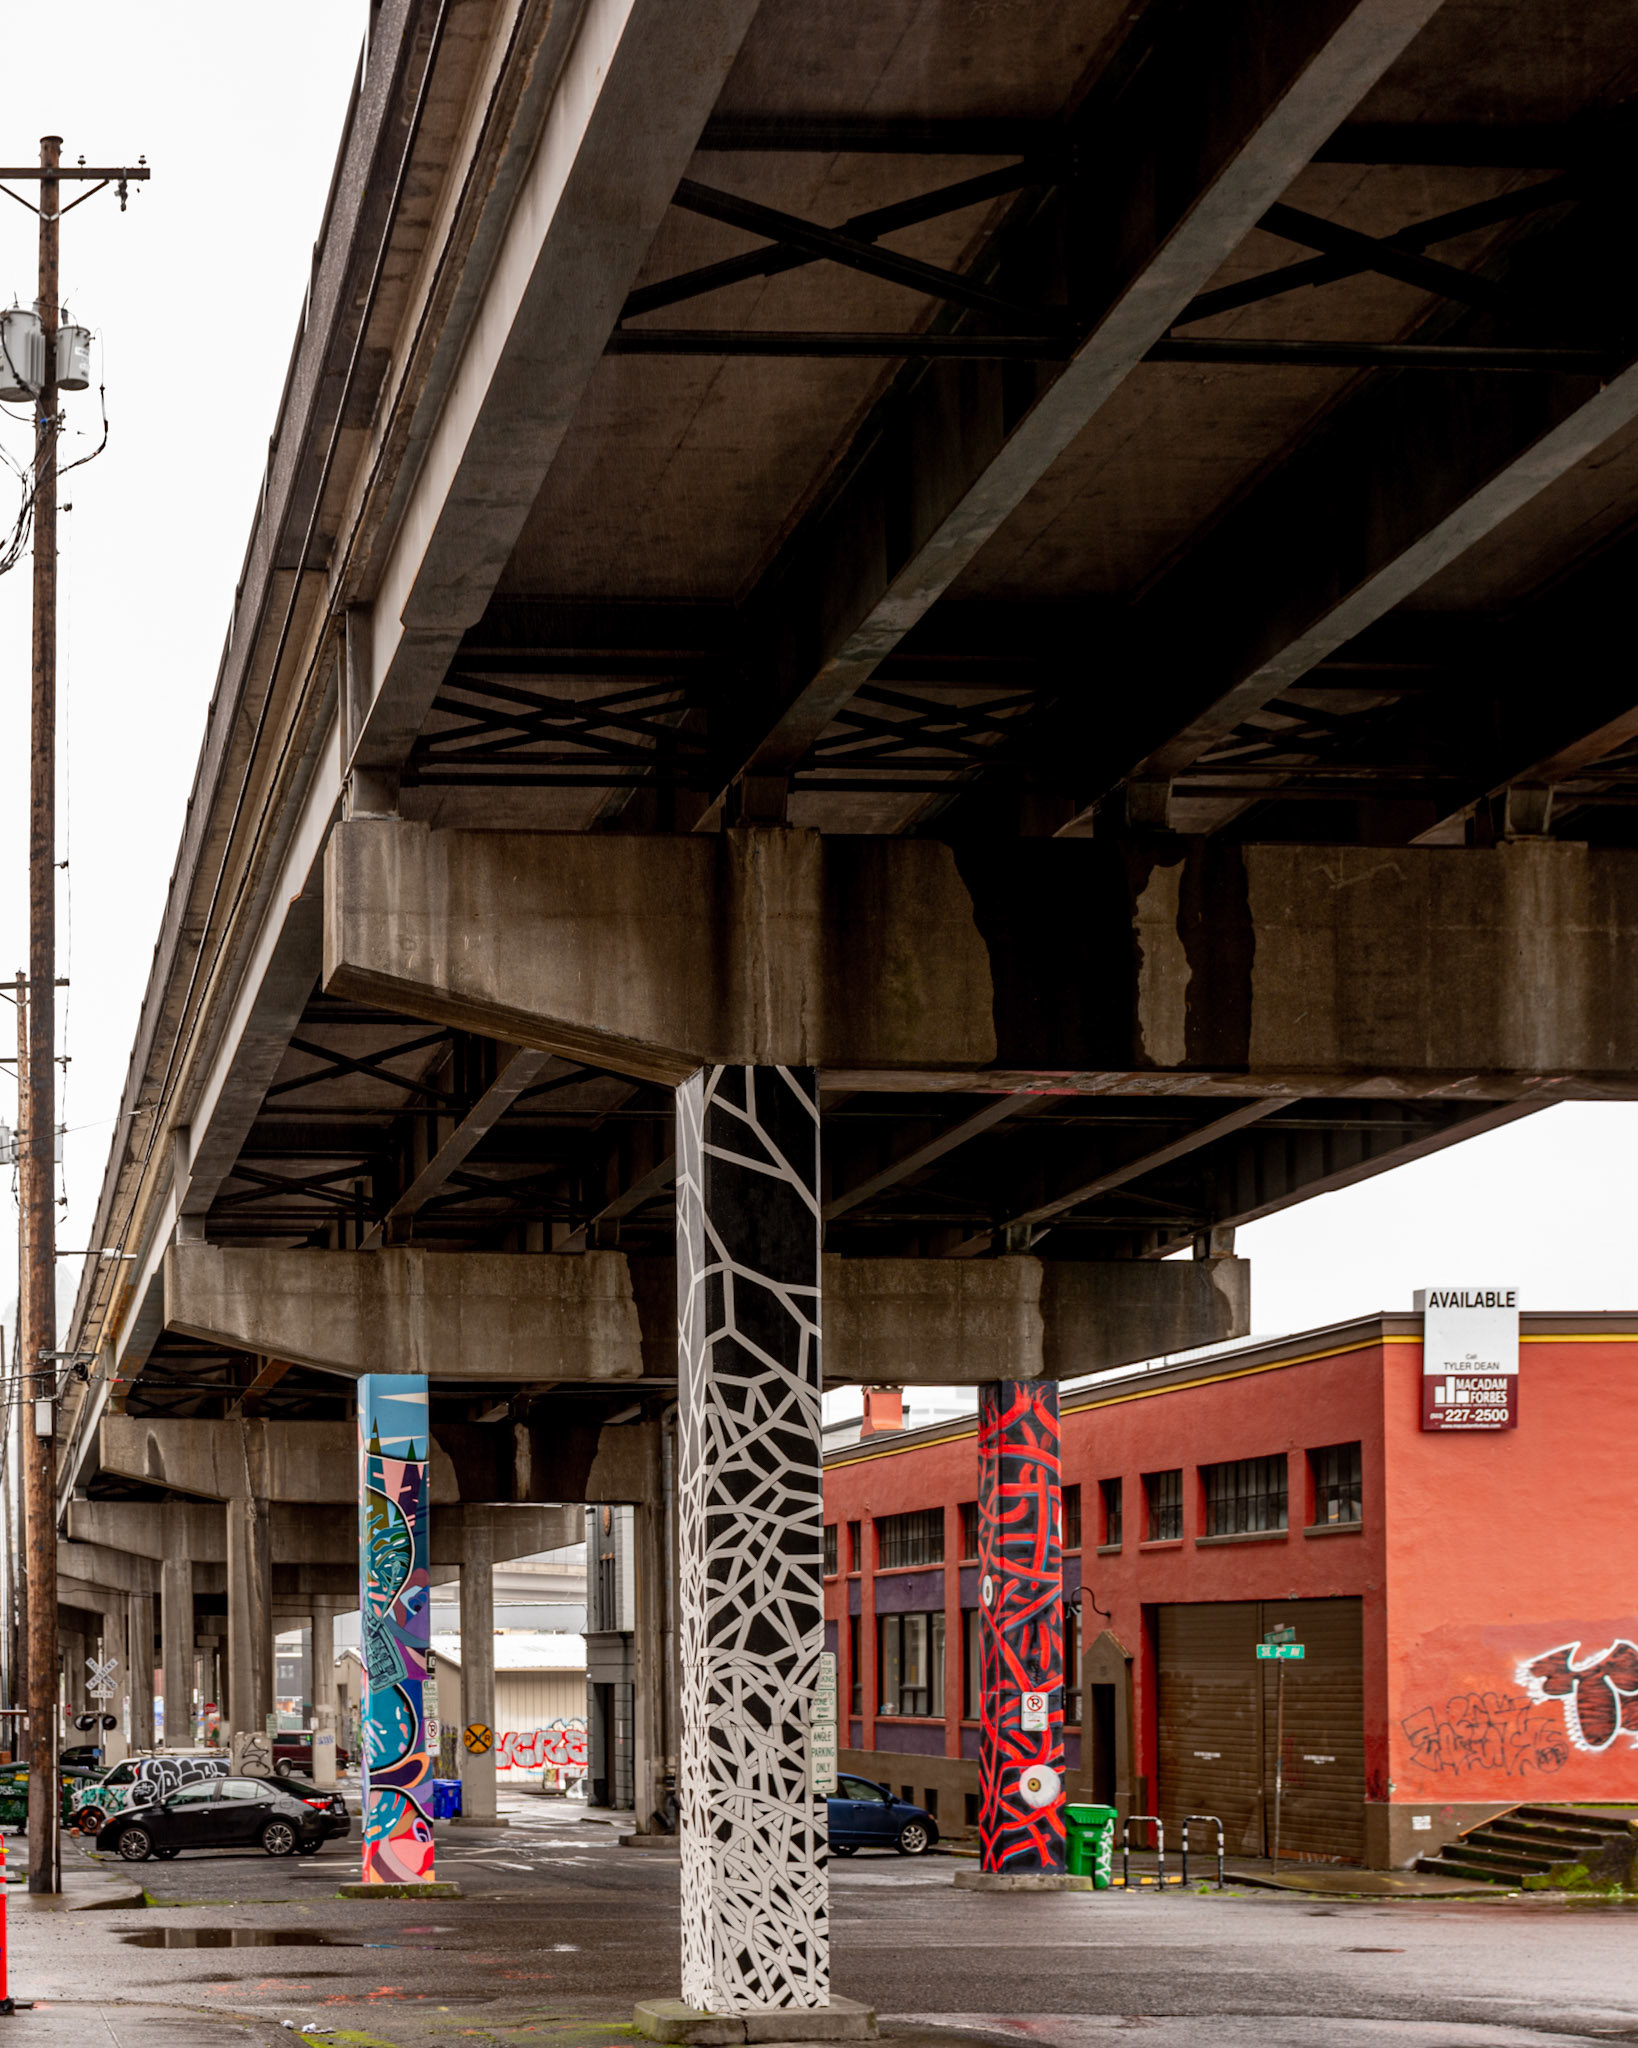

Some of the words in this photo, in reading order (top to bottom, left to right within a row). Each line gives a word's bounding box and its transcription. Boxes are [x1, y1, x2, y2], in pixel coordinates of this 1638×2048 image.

[1428, 1291, 1516, 1308] AVAILABLE
[1443, 1362, 1472, 1371] TYLER
[1474, 1362, 1500, 1371] DEAN
[1455, 1378, 1508, 1390] MACADAM
[1470, 1391, 1507, 1404] FORBES
[1445, 1408, 1509, 1422] 227-2500
[88, 1660, 116, 1688] CROSSING
[813, 1731, 832, 1742] ANGLE
[811, 1746, 836, 1758] PARKING
[815, 1762, 831, 1774] ONLY
